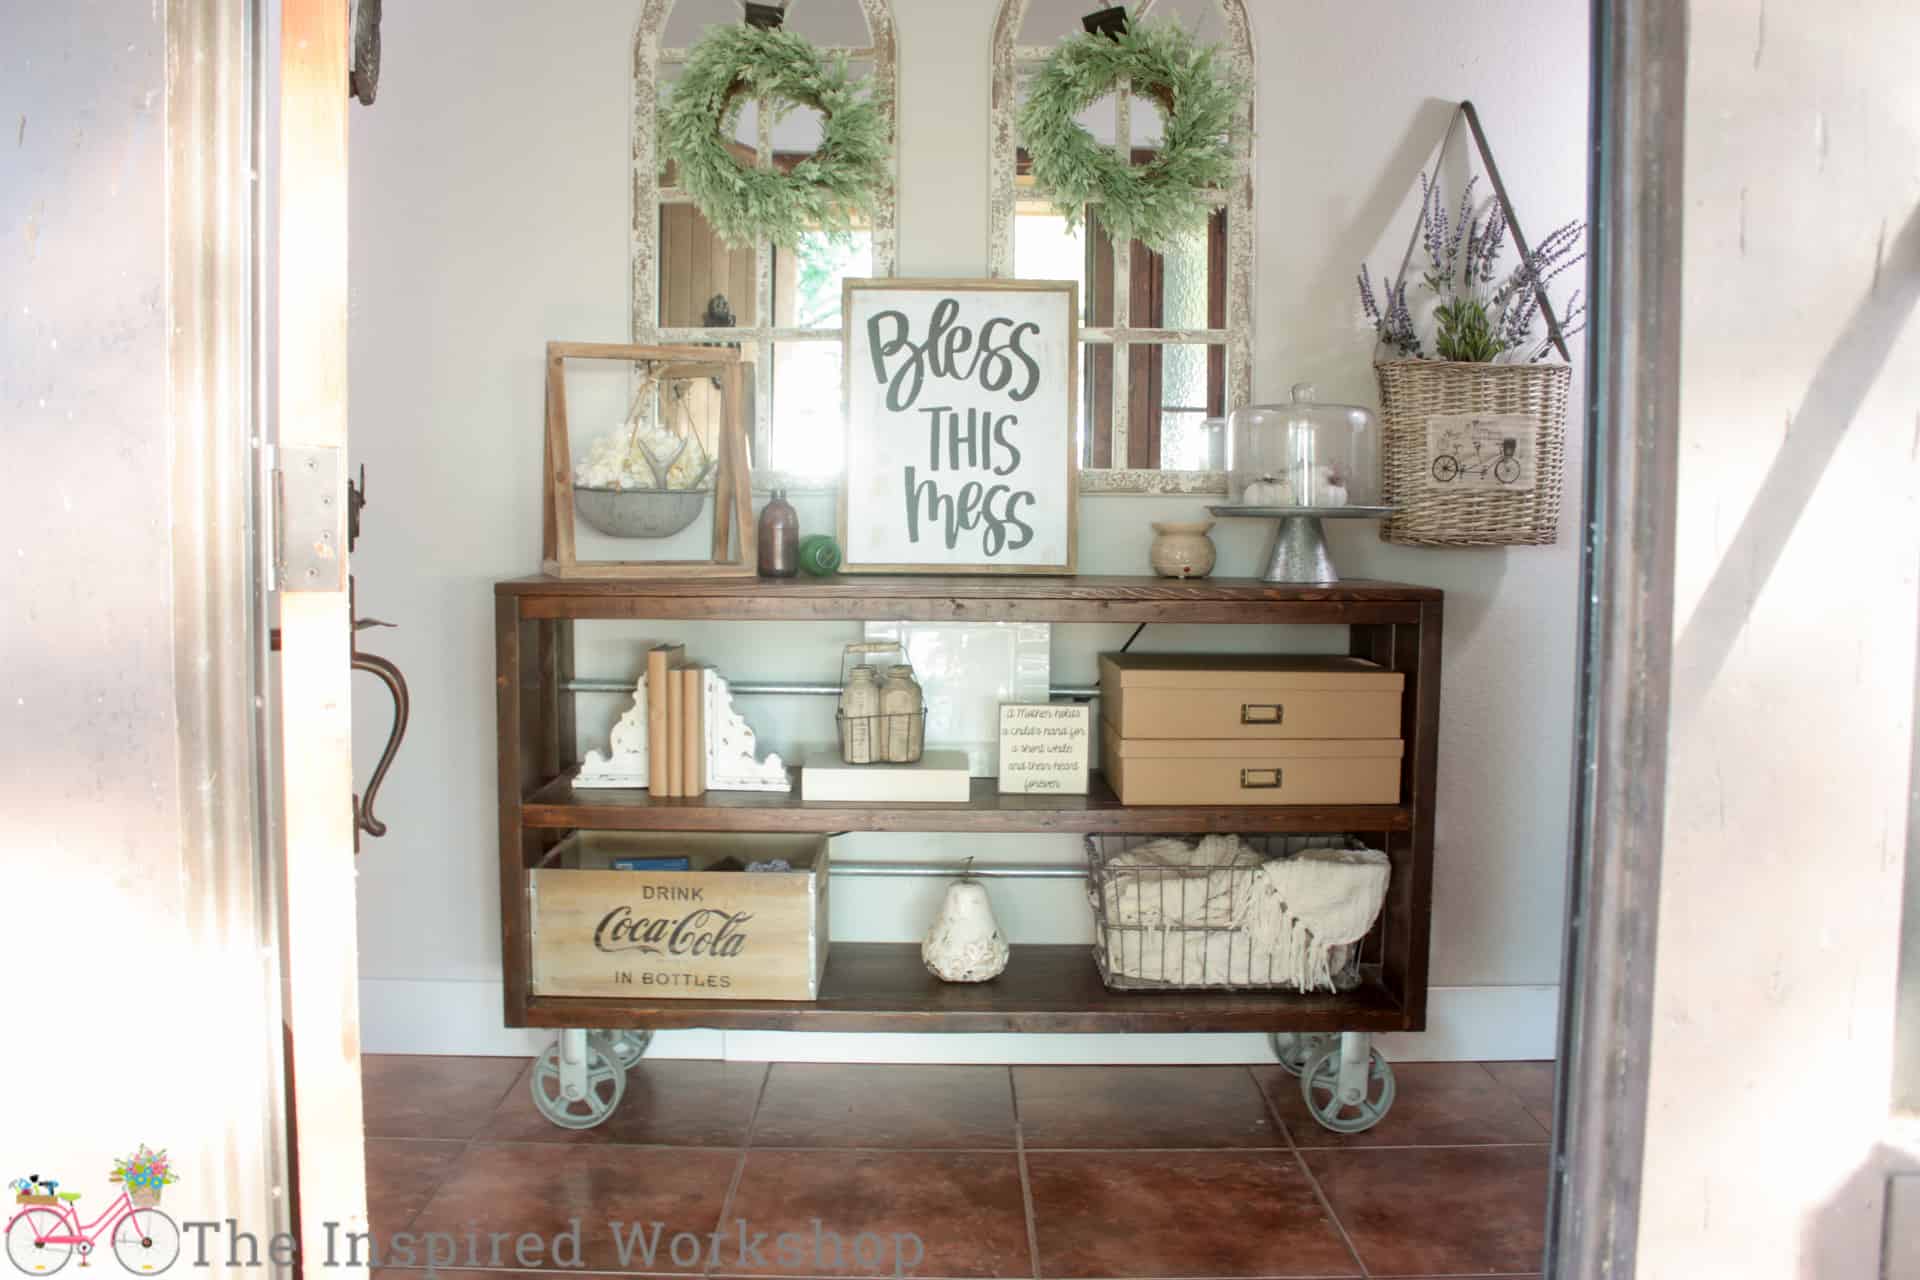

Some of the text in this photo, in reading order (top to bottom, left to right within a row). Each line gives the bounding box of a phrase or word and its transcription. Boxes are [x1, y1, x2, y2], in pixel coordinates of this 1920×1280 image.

[867, 298, 1040, 412] Bless
[918, 406, 1021, 476] THIS
[642, 885, 704, 901] DRINK
[615, 971, 731, 988] IN BOTTLES
